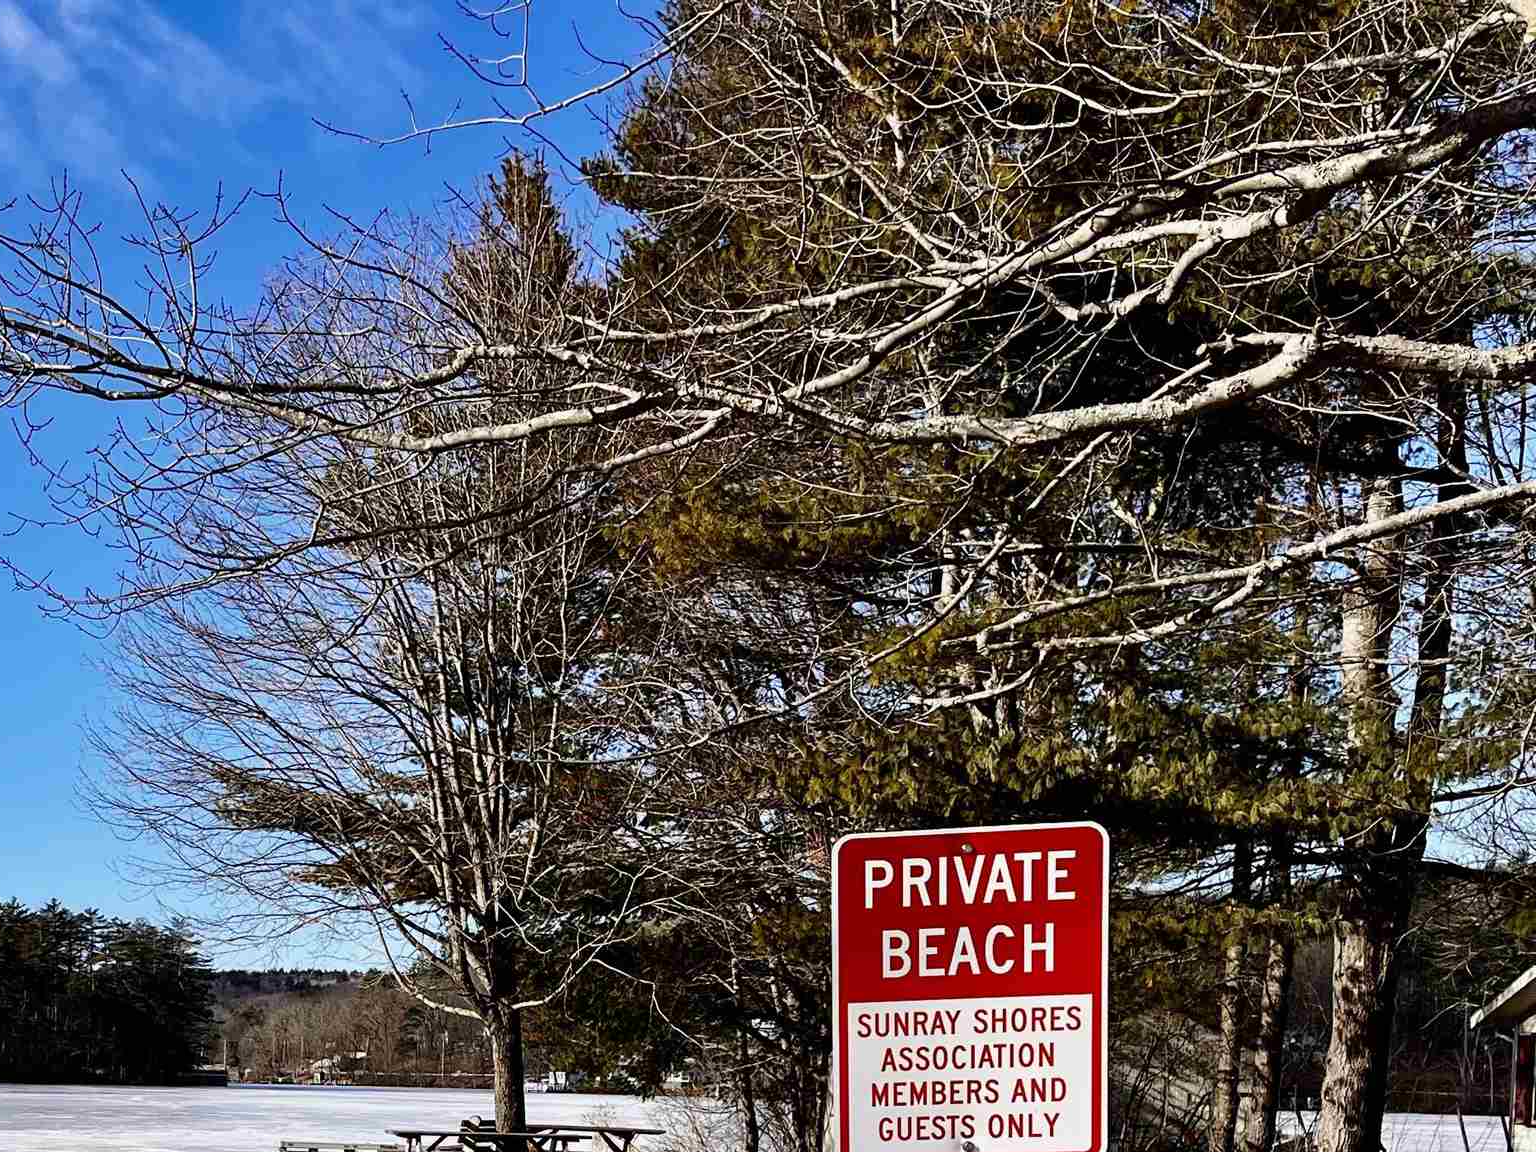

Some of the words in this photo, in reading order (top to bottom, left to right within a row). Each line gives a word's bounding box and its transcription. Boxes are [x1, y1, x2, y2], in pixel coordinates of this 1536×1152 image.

[864, 850, 1076, 909] PRIVATE
[882, 923, 1054, 978] BEACH
[857, 1010, 961, 1038] SUNRAY
[973, 1007, 1082, 1033] SHORES
[881, 1042, 1054, 1072] ASSOCIATION
[871, 1080, 999, 1107] MEMBERS
[1012, 1078, 1066, 1104] AND
[878, 1115, 975, 1141] GUESTS
[988, 1113, 1060, 1138] ONLY
